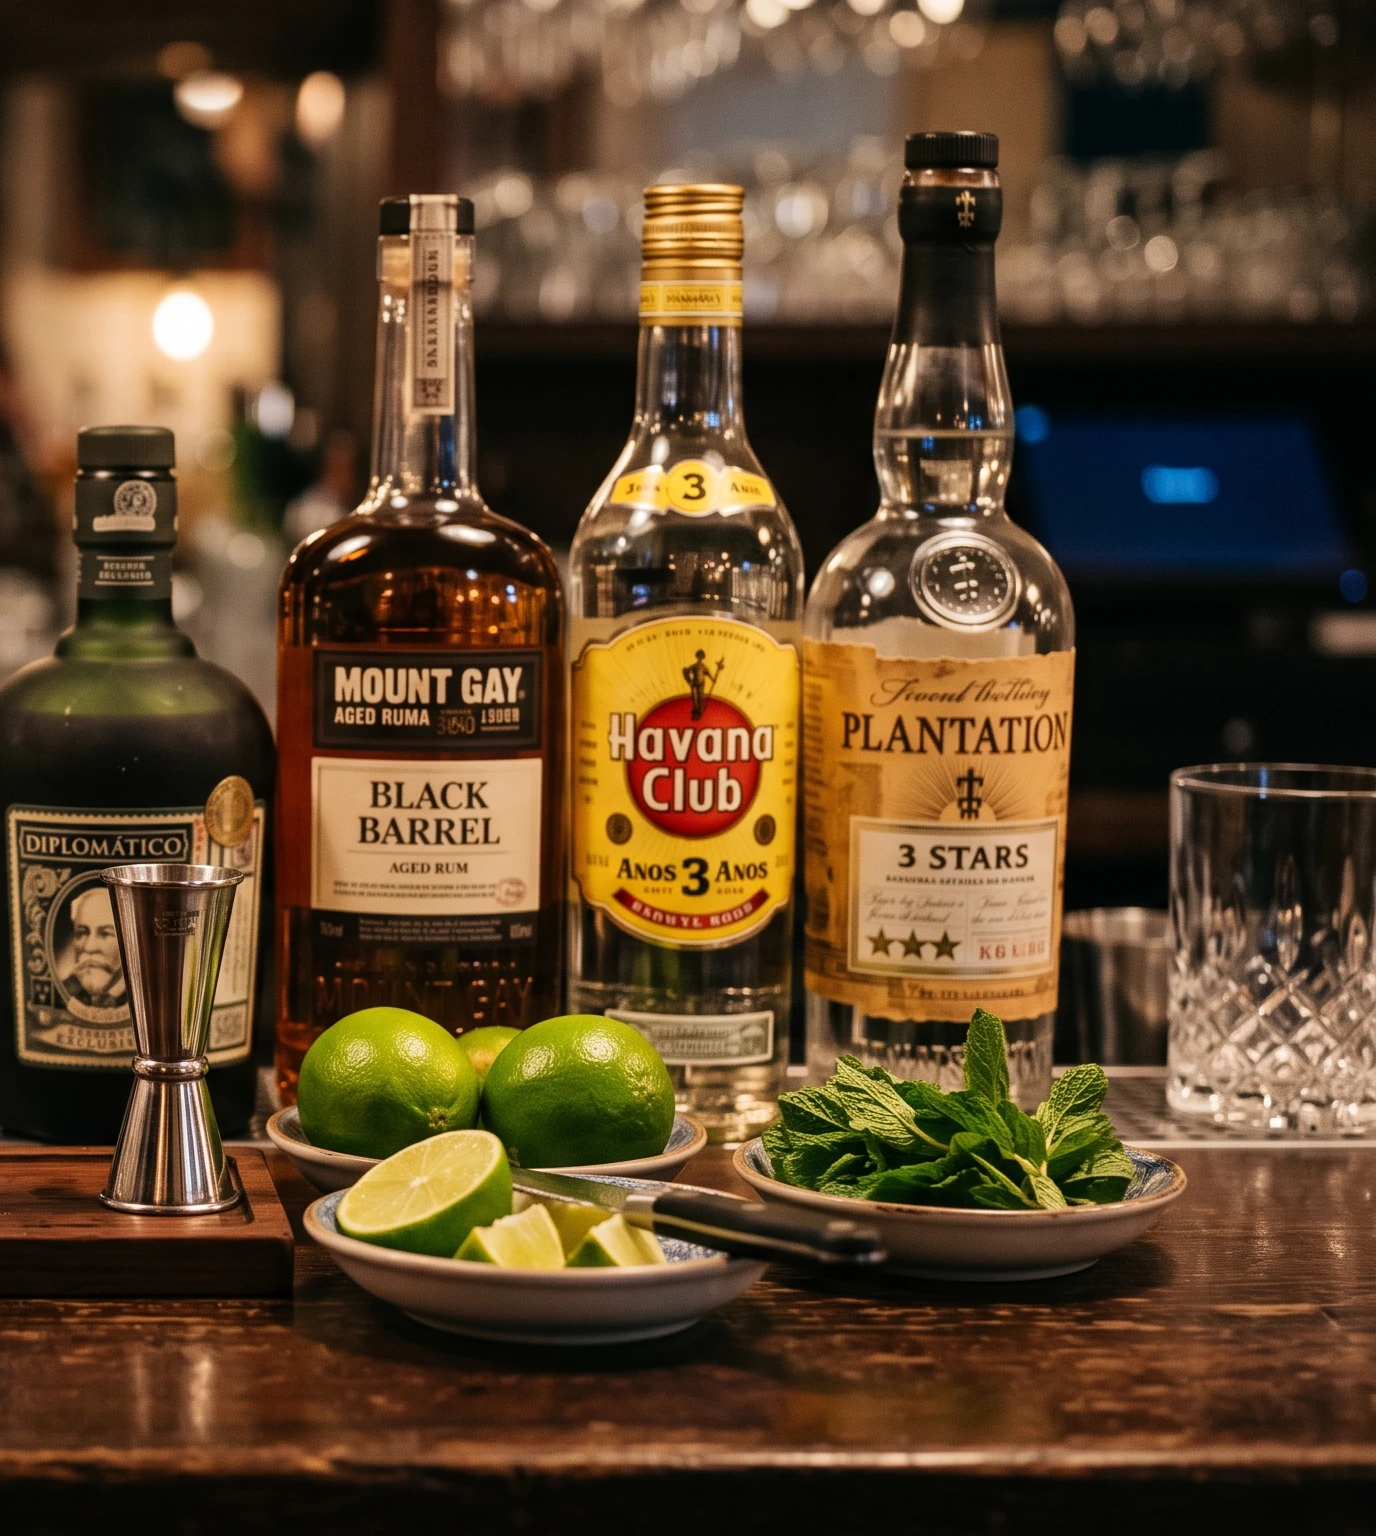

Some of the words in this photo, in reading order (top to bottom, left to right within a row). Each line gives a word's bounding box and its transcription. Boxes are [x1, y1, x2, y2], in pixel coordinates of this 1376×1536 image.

[683, 473, 707, 500] 3
[334, 666, 453, 705] MOUNT
[461, 667, 522, 704] GAY
[334, 706, 376, 725] AGED
[382, 708, 430, 726] RUMA
[608, 713, 774, 763] Havana
[841, 711, 1068, 755] PLANTATION
[370, 780, 490, 810] BLACK
[642, 766, 743, 812] Club
[26, 834, 182, 856] DIPLOMÁTICO
[358, 816, 501, 846] BARREL
[389, 862, 431, 875] AGED
[435, 862, 469, 875] RUM
[898, 844, 917, 868] 3
[929, 844, 1029, 870] STARS
[681, 857, 710, 897] 3
